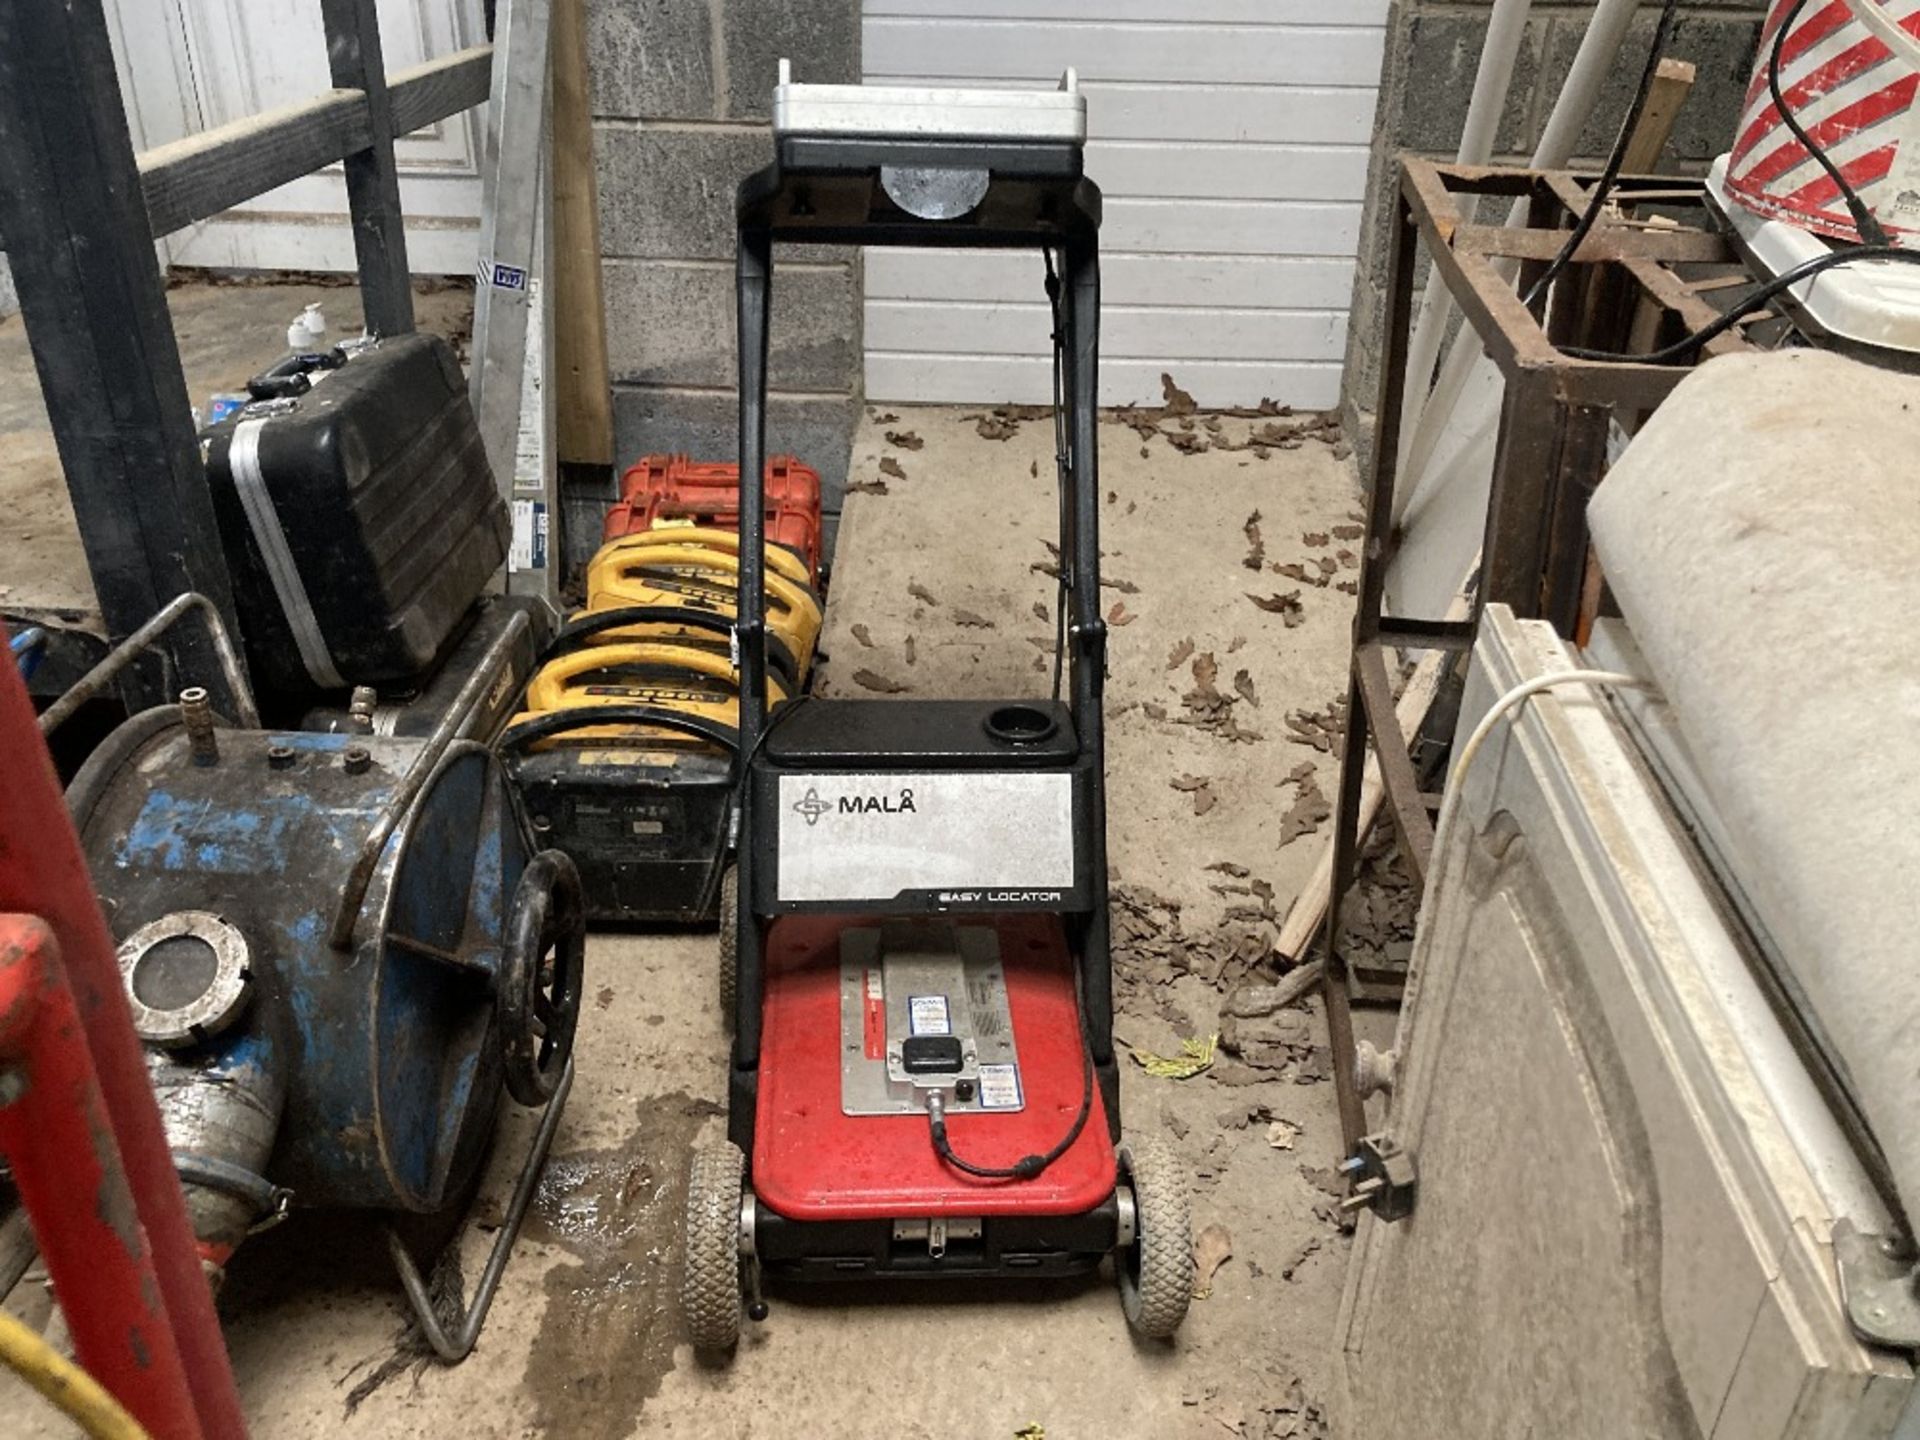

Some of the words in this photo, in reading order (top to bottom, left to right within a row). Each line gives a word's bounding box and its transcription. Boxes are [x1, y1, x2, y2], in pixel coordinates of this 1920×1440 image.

[839, 788, 916, 813] MALÅ
[939, 892, 982, 902] EASY
[987, 892, 1061, 901] LOCATOR
